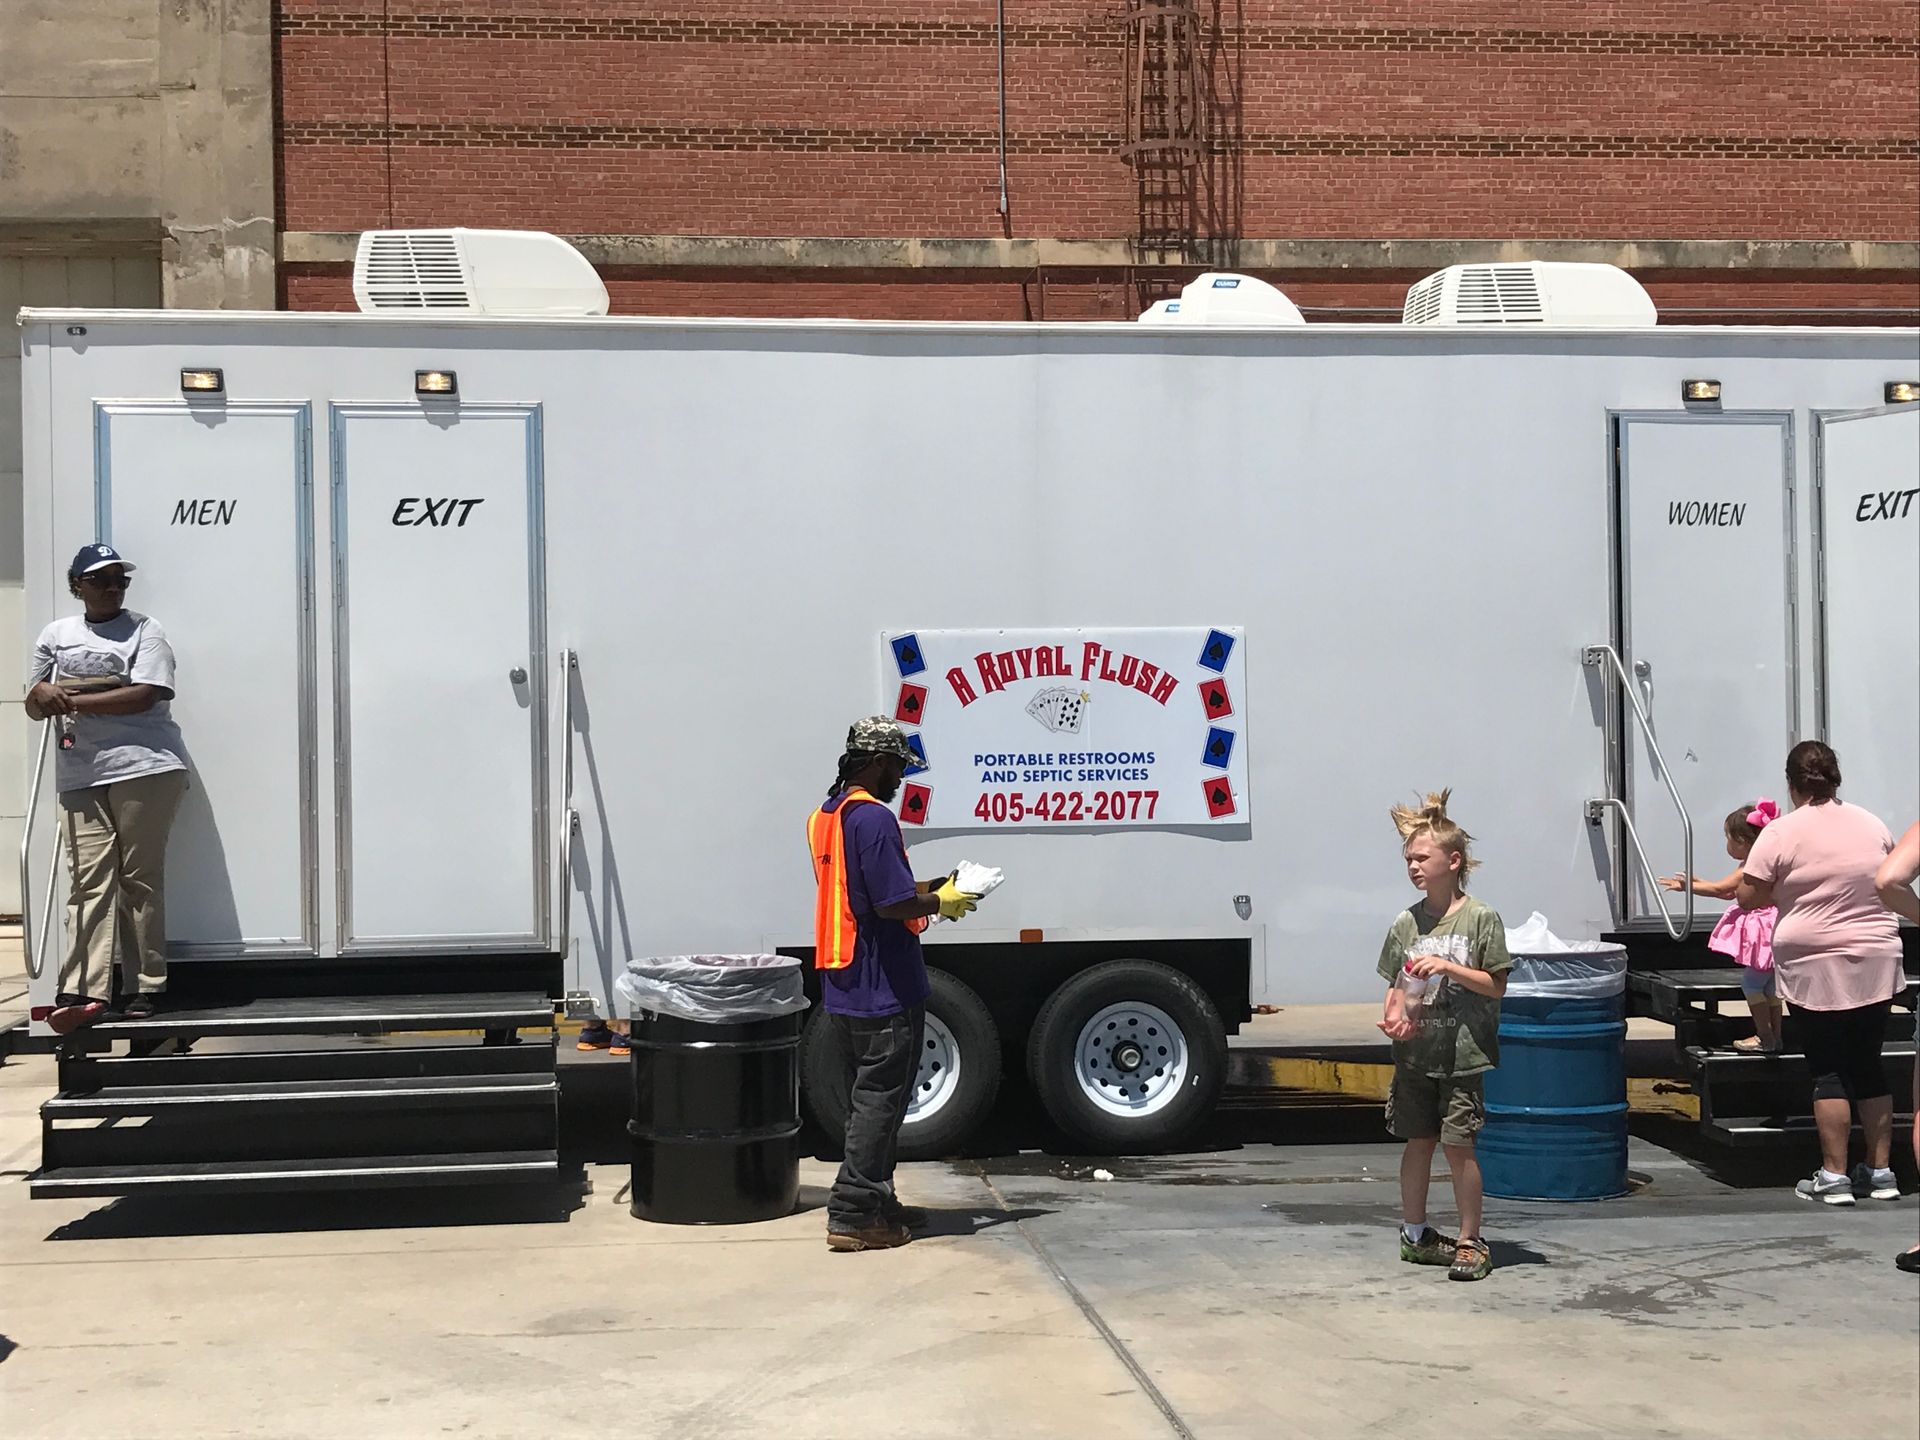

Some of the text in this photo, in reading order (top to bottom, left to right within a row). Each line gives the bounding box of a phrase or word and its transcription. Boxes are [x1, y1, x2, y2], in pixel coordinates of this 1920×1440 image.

[170, 499, 236, 526] MEN
[391, 497, 485, 527] EXIT
[1668, 501, 1747, 527] WOMEN
[1855, 488, 1919, 522] EXIT
[946, 667, 979, 708] A
[974, 645, 1072, 695] ROYAL
[1080, 641, 1181, 707] FLUSH
[974, 751, 1156, 767] PORTABLE RESTROOMS
[981, 767, 1149, 784] AND SEPTIC SERVICES
[974, 789, 1160, 823] 405-422-2077
